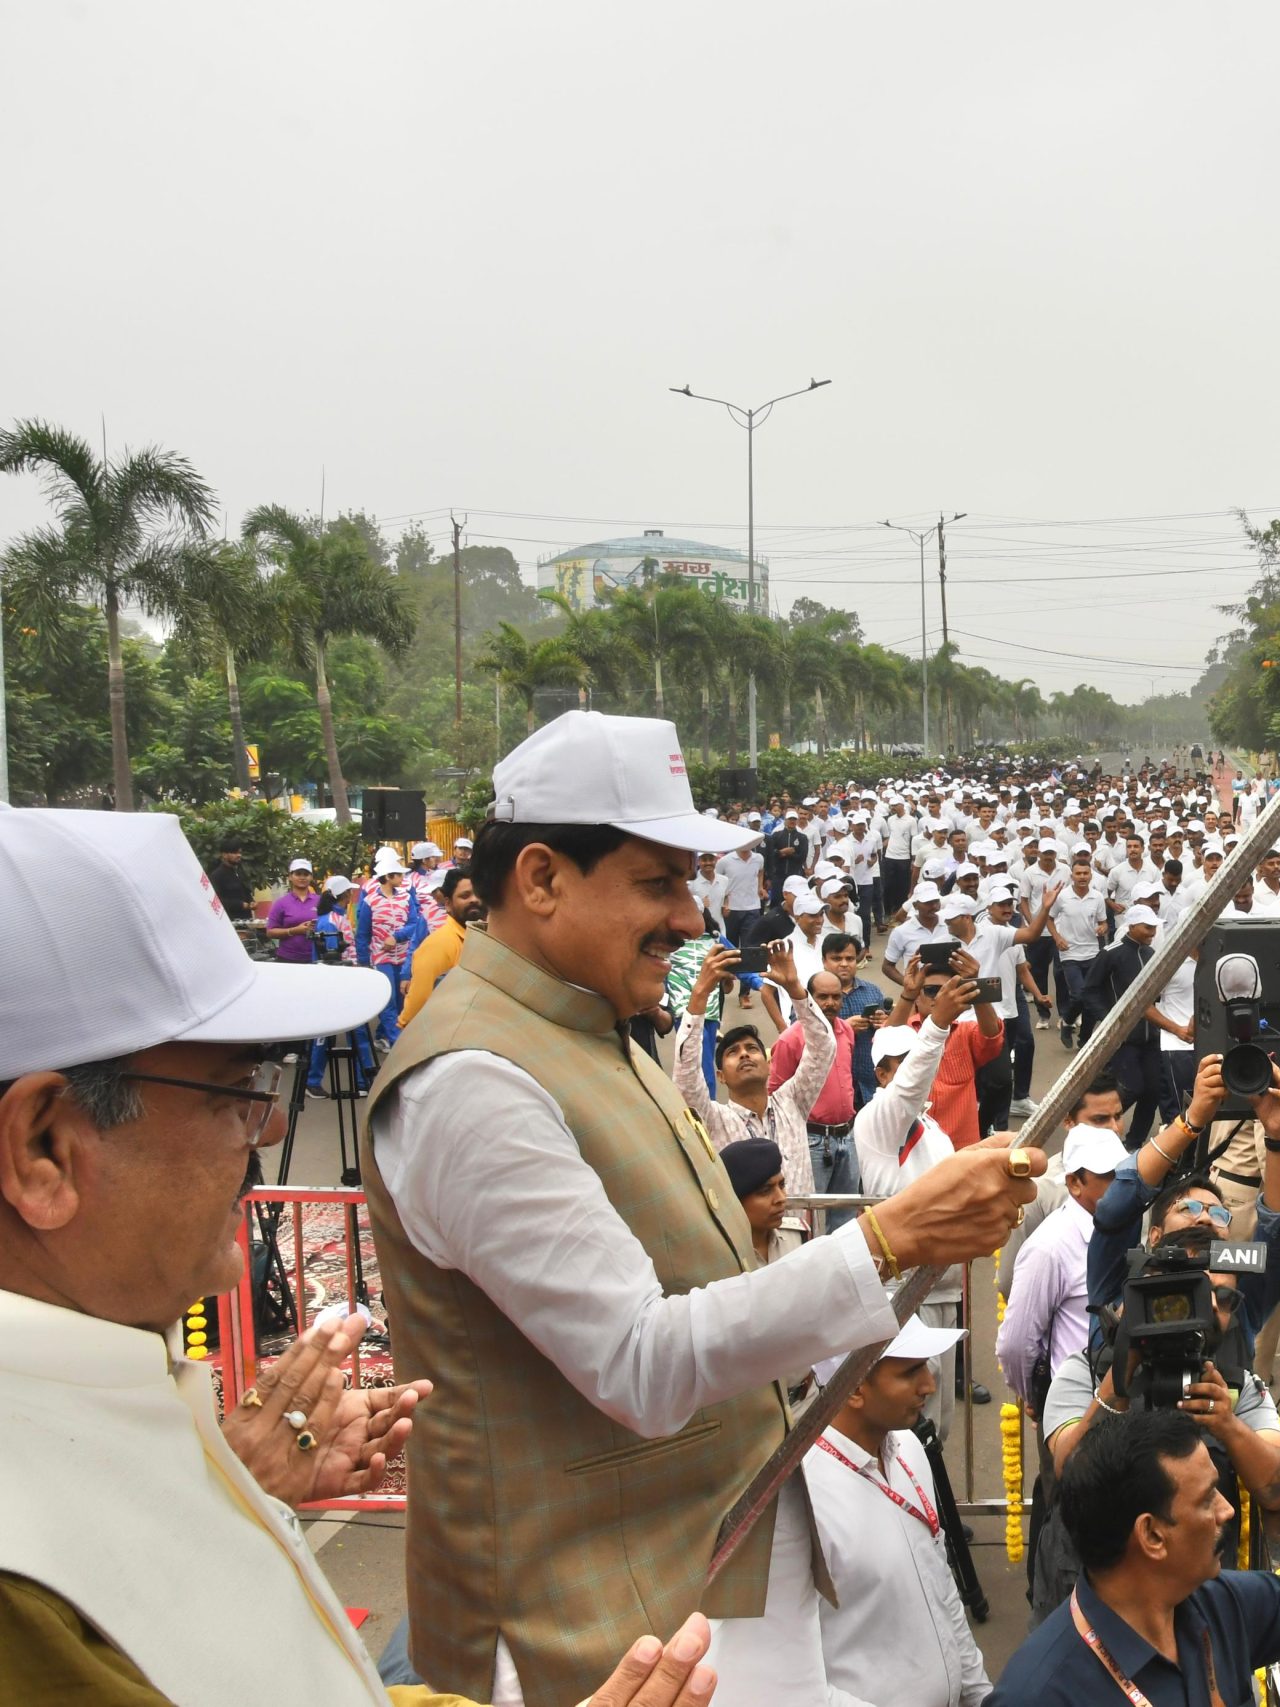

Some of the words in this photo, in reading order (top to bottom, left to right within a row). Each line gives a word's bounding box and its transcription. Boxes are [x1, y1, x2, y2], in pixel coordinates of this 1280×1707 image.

[662, 560, 711, 575] स्वच्छ
[688, 571, 761, 602] र्वेक्षण
[1217, 1248, 1258, 1265] ANI
